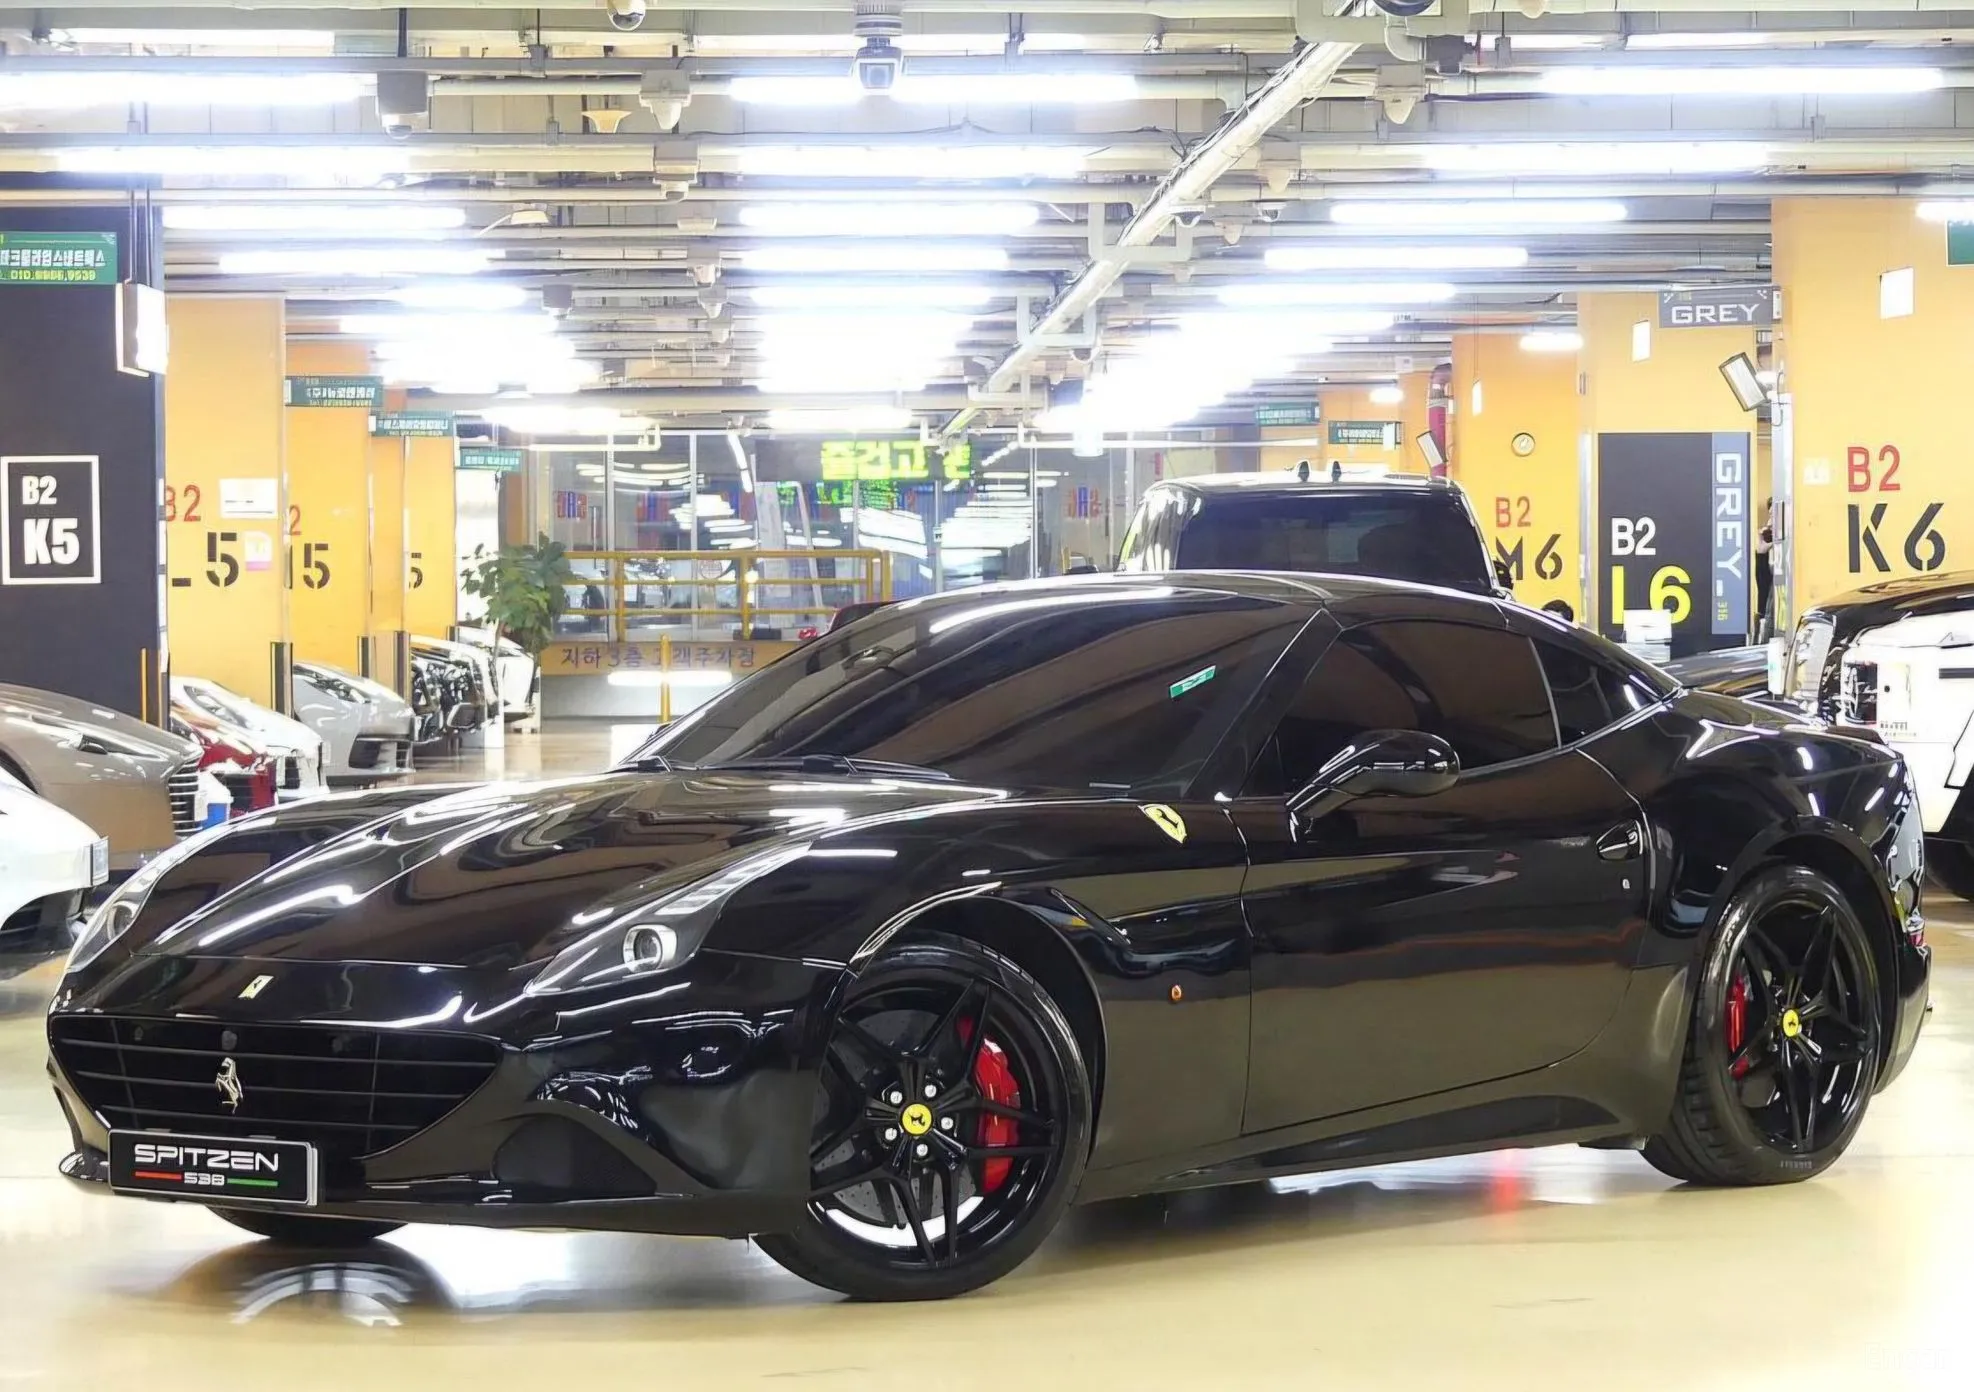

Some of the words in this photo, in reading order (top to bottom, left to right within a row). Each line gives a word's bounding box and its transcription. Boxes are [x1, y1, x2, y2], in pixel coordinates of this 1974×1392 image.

[1672, 303, 1759, 323] GREY
[1847, 445, 1900, 492] B2
[22, 475, 57, 505] B2
[1495, 496, 1531, 528] B2
[24, 517, 80, 565] K5
[1611, 516, 1656, 556] B2
[1847, 502, 1946, 573] K6
[1495, 533, 1563, 581] M6
[561, 646, 601, 668] 지하
[134, 1143, 279, 1172] SPITZEN
